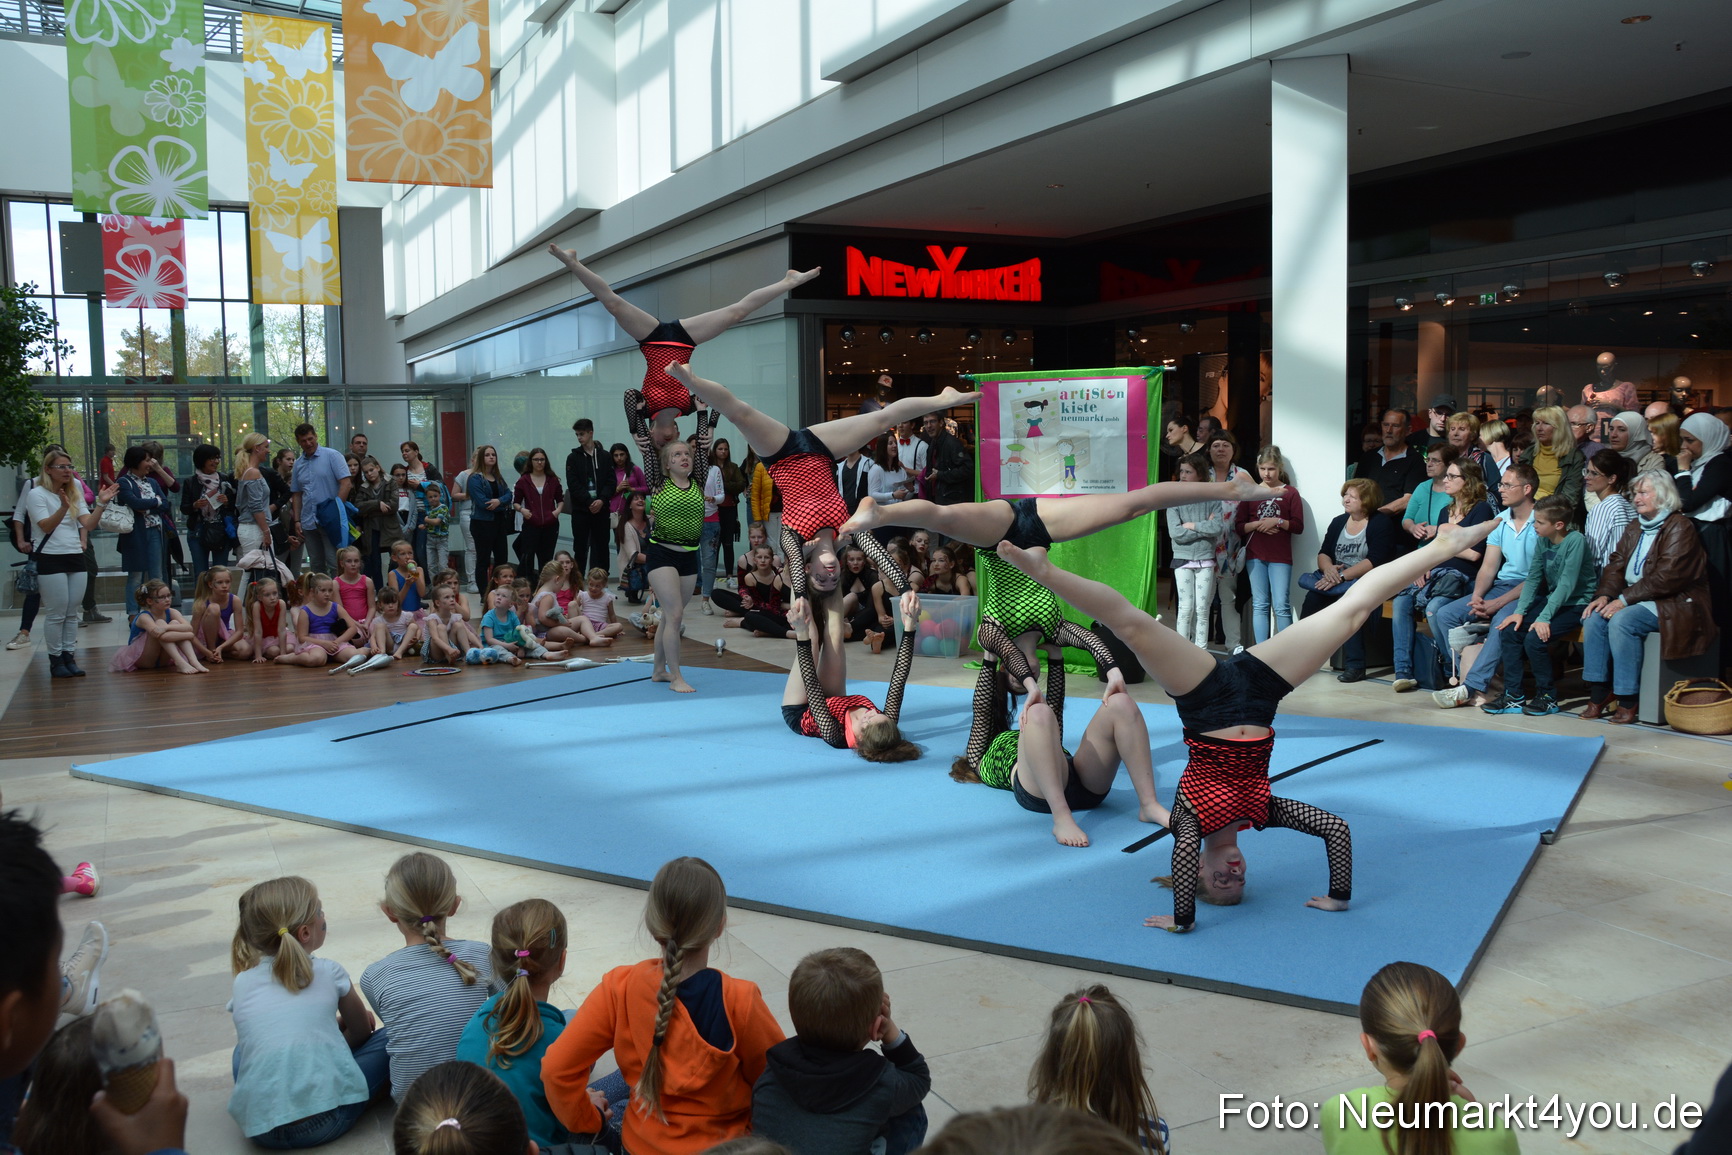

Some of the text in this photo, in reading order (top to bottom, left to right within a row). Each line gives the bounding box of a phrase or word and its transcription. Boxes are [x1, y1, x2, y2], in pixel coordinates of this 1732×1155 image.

[1061, 401, 1097, 413] kiste
[1061, 414, 1104, 422] neumarkt
[1337, 544, 1361, 553] EAUTY
